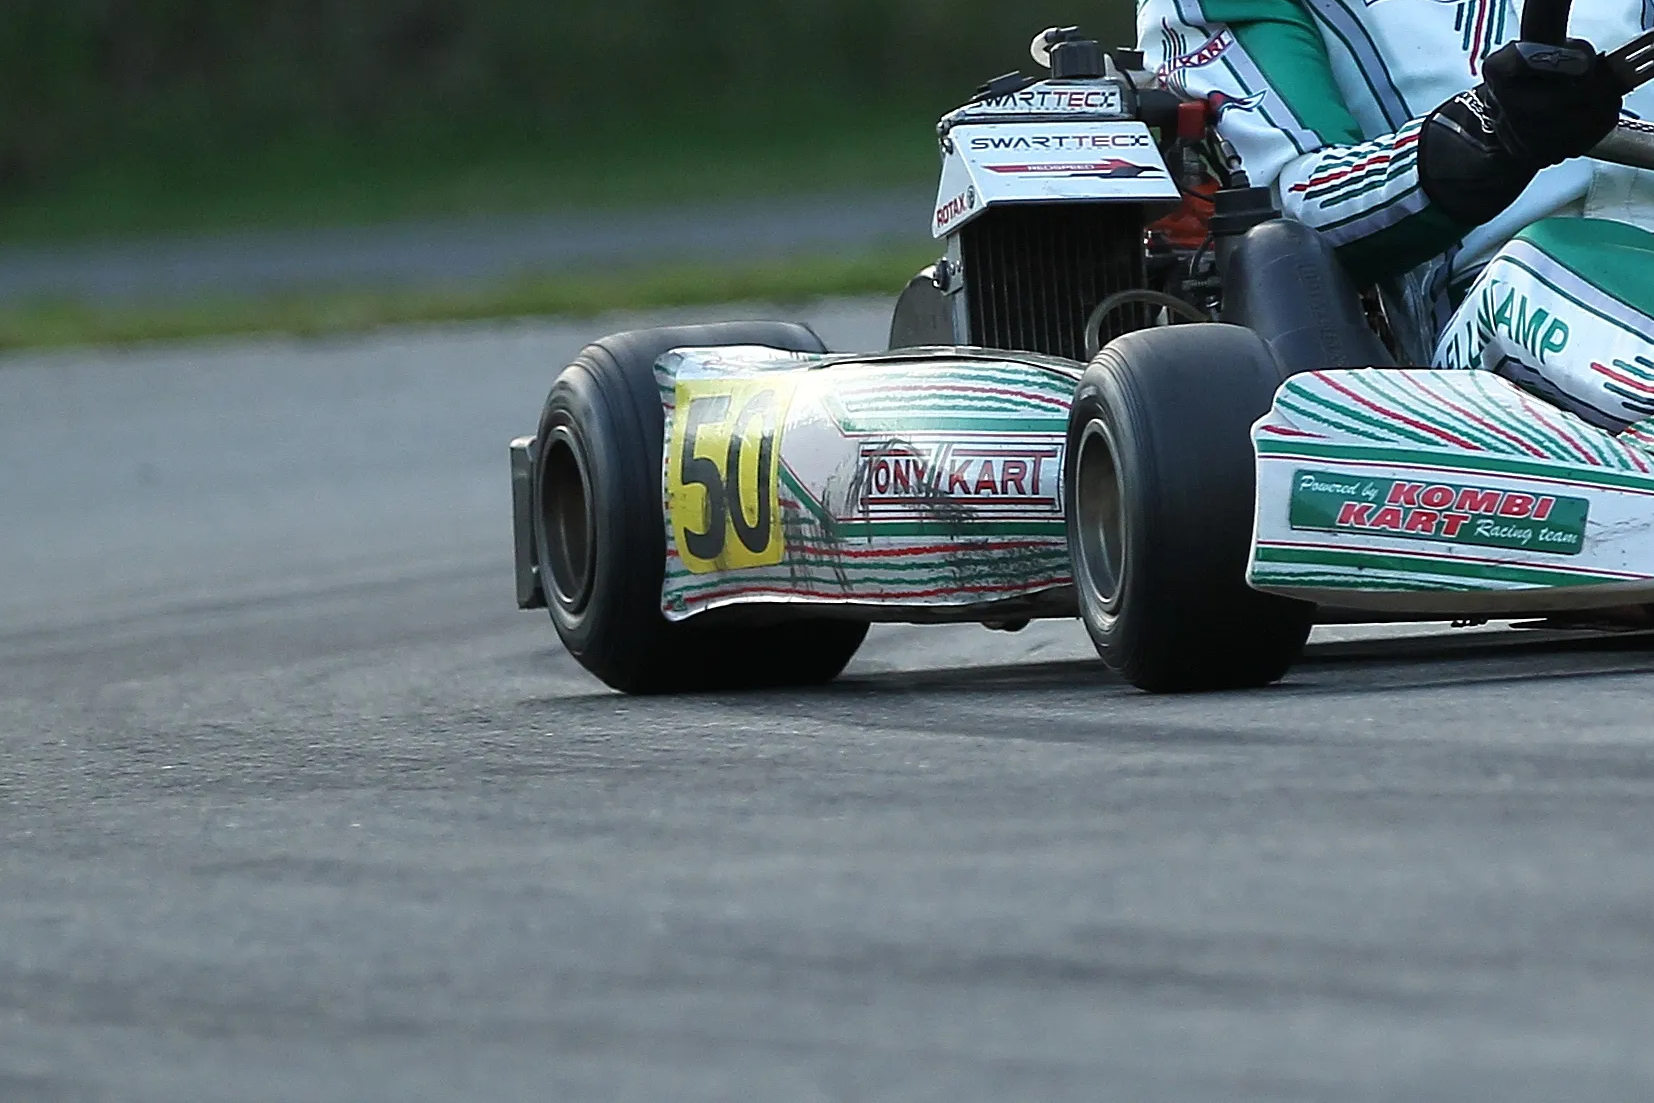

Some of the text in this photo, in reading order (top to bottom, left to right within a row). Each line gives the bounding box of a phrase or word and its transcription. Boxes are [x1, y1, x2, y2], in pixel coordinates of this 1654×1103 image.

[936, 192, 967, 228] ROTAX
[682, 389, 774, 560] 50
[950, 449, 1058, 496] KART
[1299, 475, 1556, 520] Powered by KOMBI
[1336, 502, 1579, 545] KART Racing team
